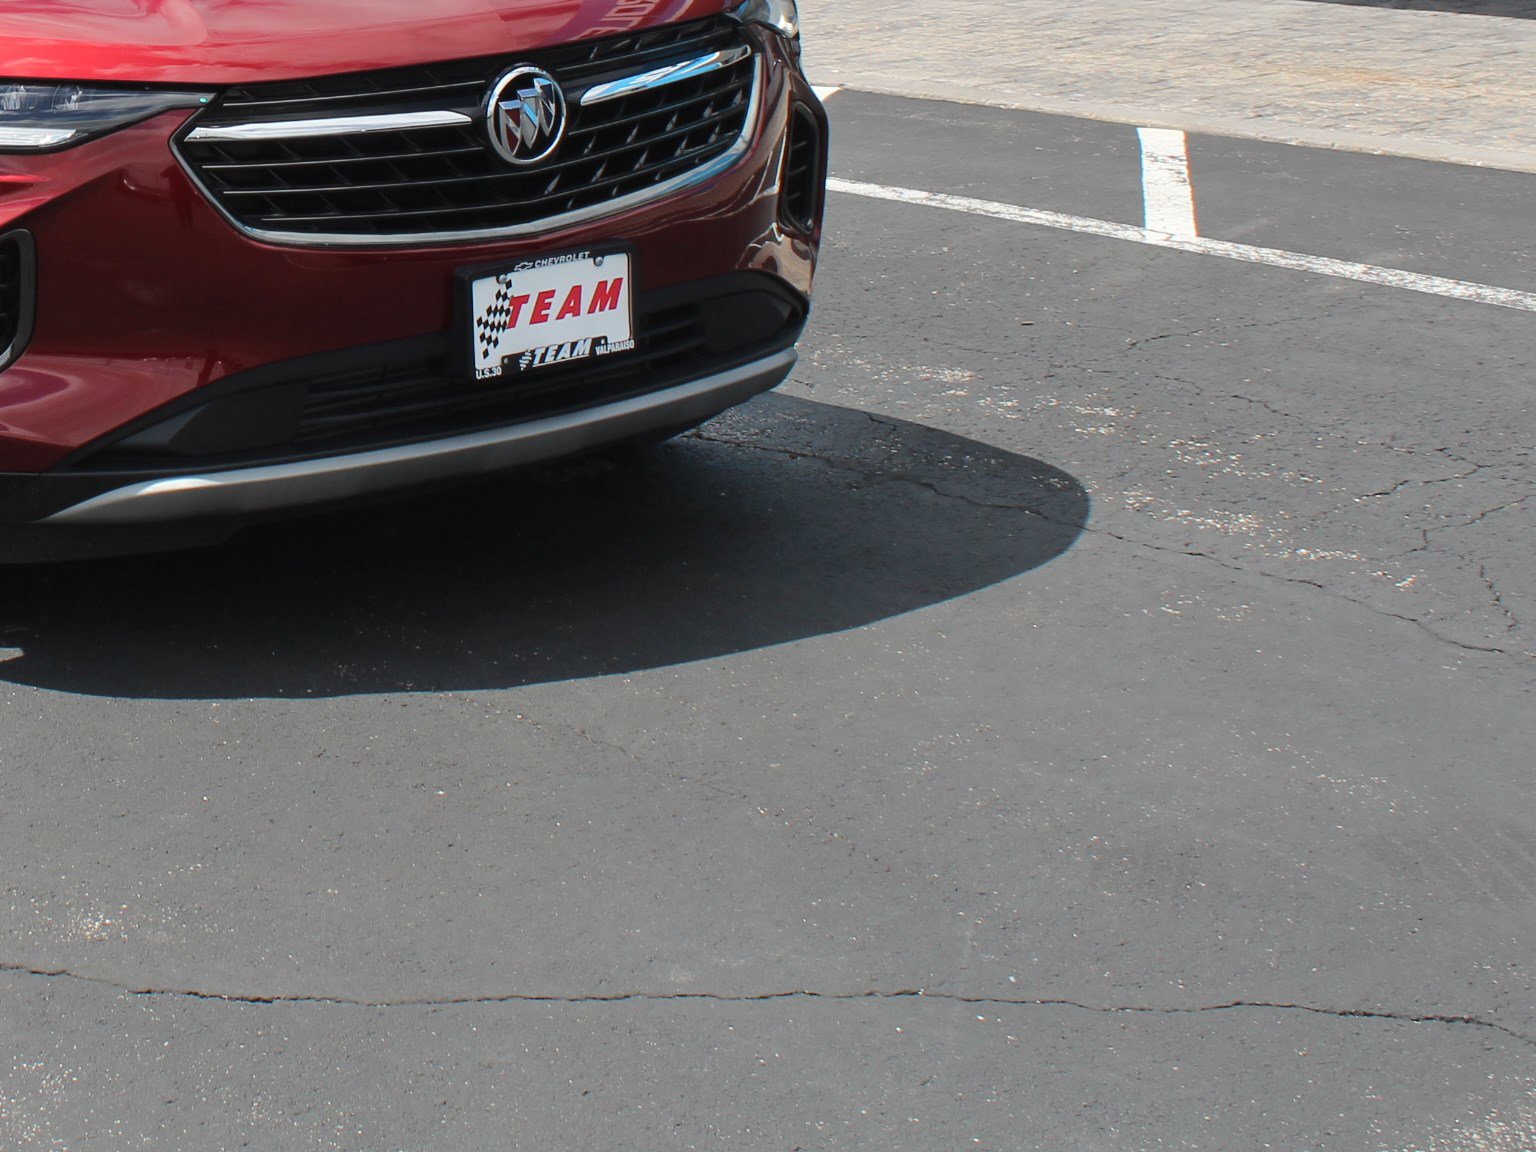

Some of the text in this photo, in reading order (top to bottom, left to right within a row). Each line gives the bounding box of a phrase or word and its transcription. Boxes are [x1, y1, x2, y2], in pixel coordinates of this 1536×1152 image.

[534, 251, 591, 269] CHEVROLET
[506, 277, 624, 329] TEAM
[532, 339, 592, 365] TEAM
[595, 339, 635, 356] VALPARAISO
